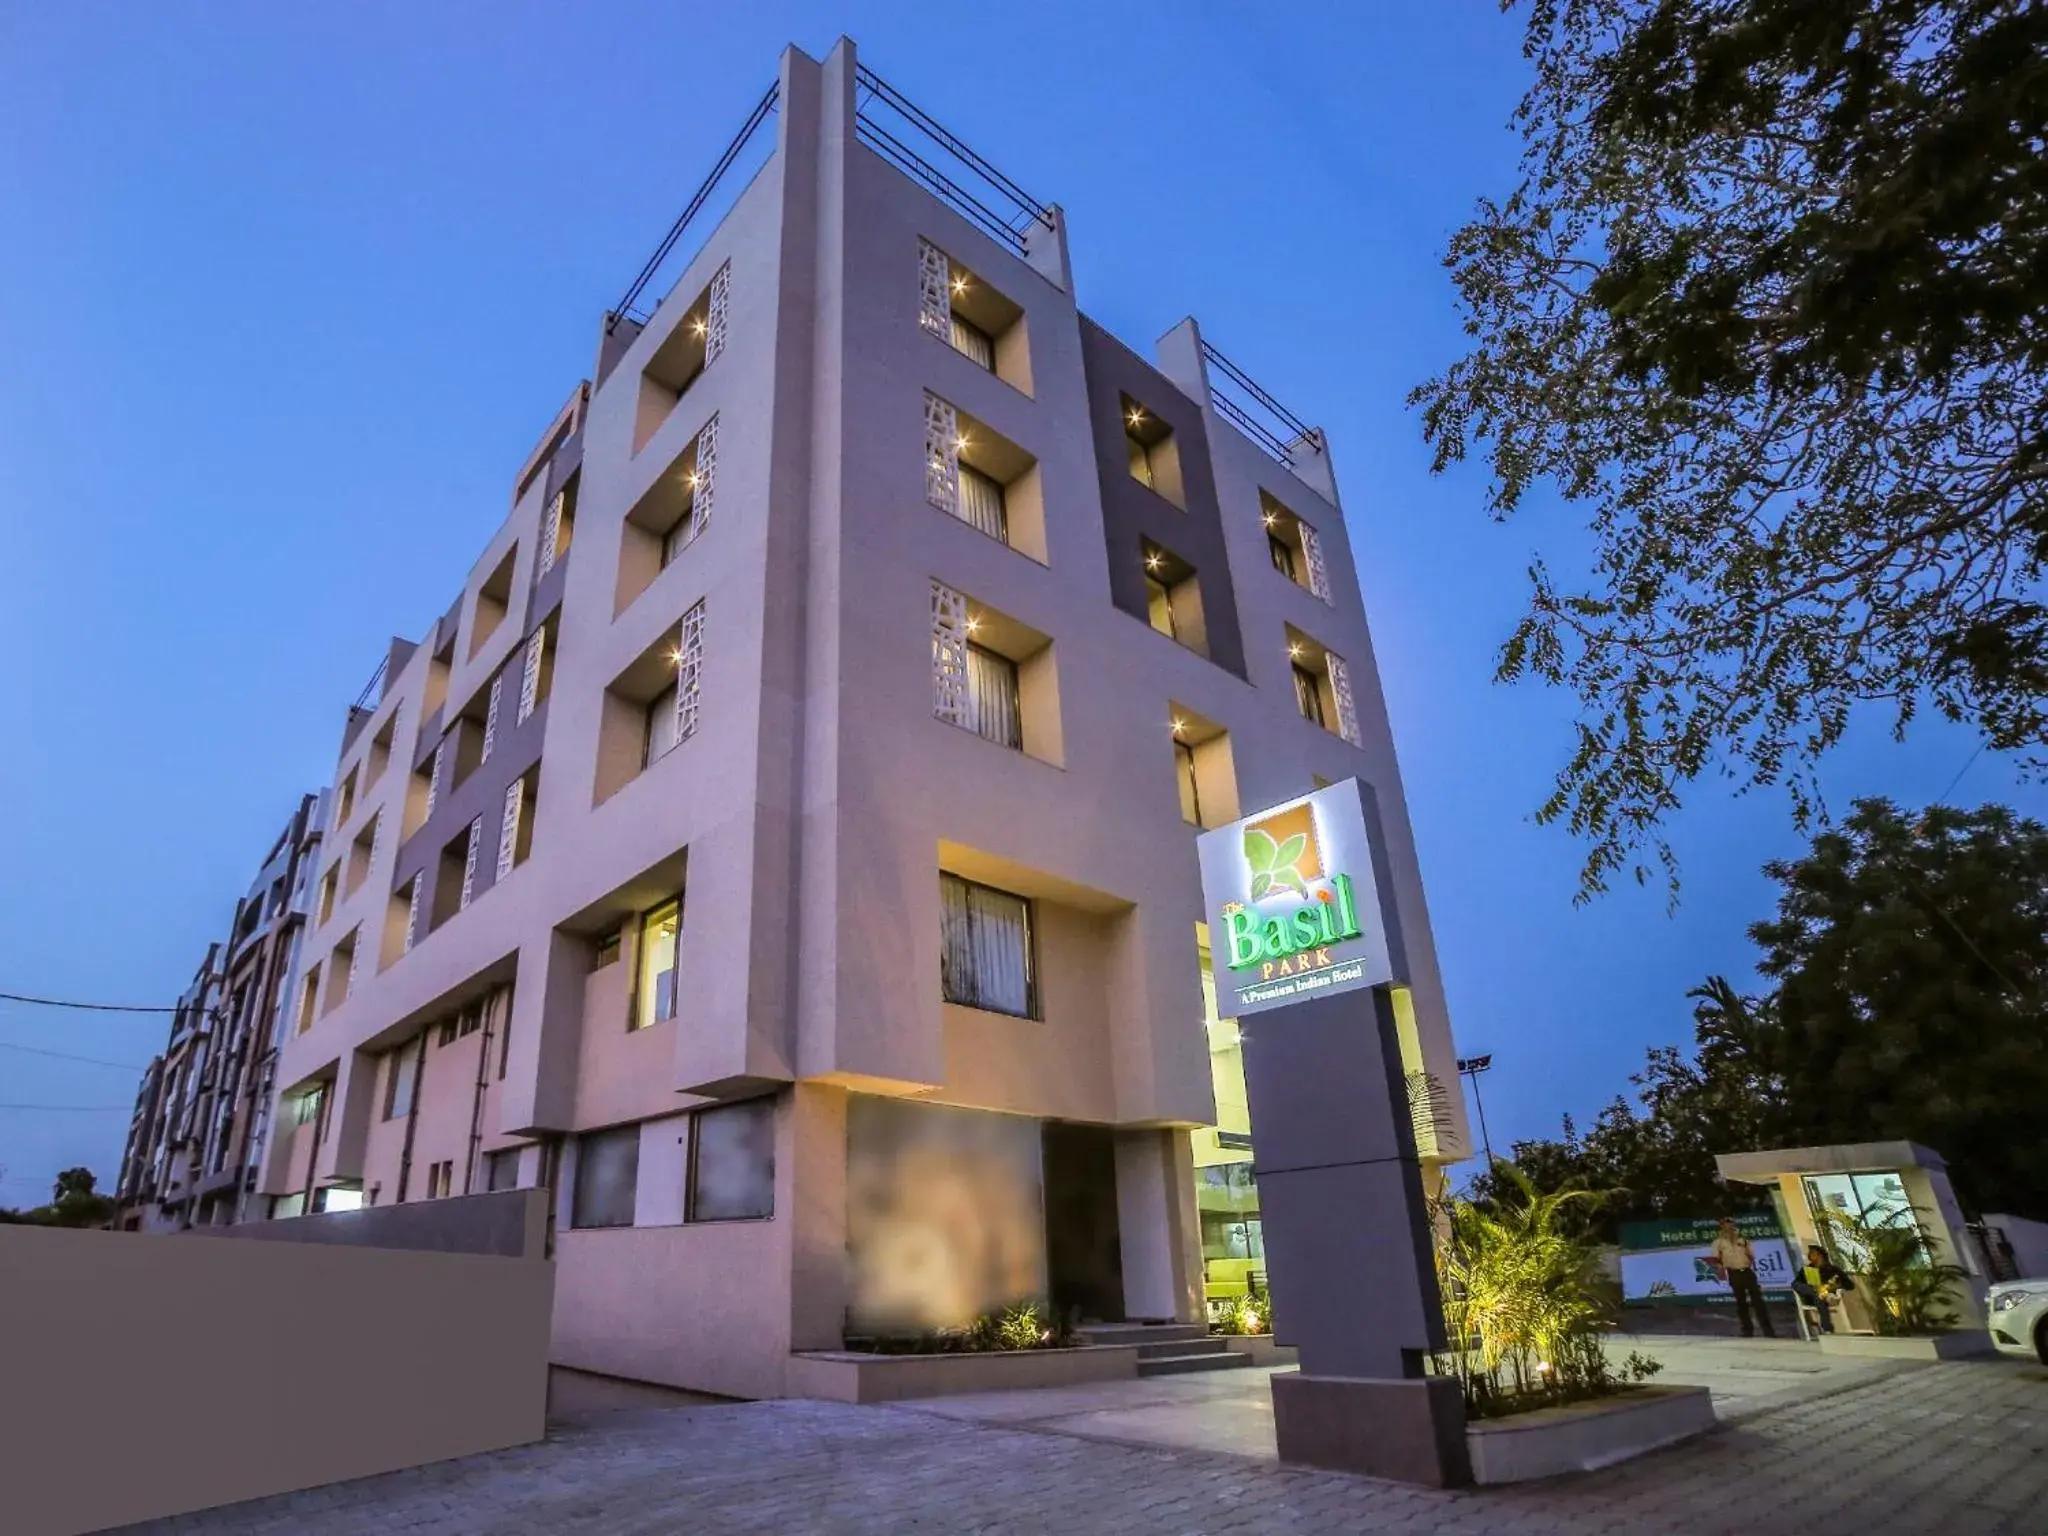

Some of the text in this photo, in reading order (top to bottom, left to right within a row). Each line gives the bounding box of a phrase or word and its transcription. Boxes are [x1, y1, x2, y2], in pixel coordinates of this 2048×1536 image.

[1222, 873, 1364, 970] Basil
[1262, 948, 1331, 980] PARK
[1240, 964, 1363, 1005] A Premium Indian Hotel
[1661, 1230, 1698, 1242] Hotel
